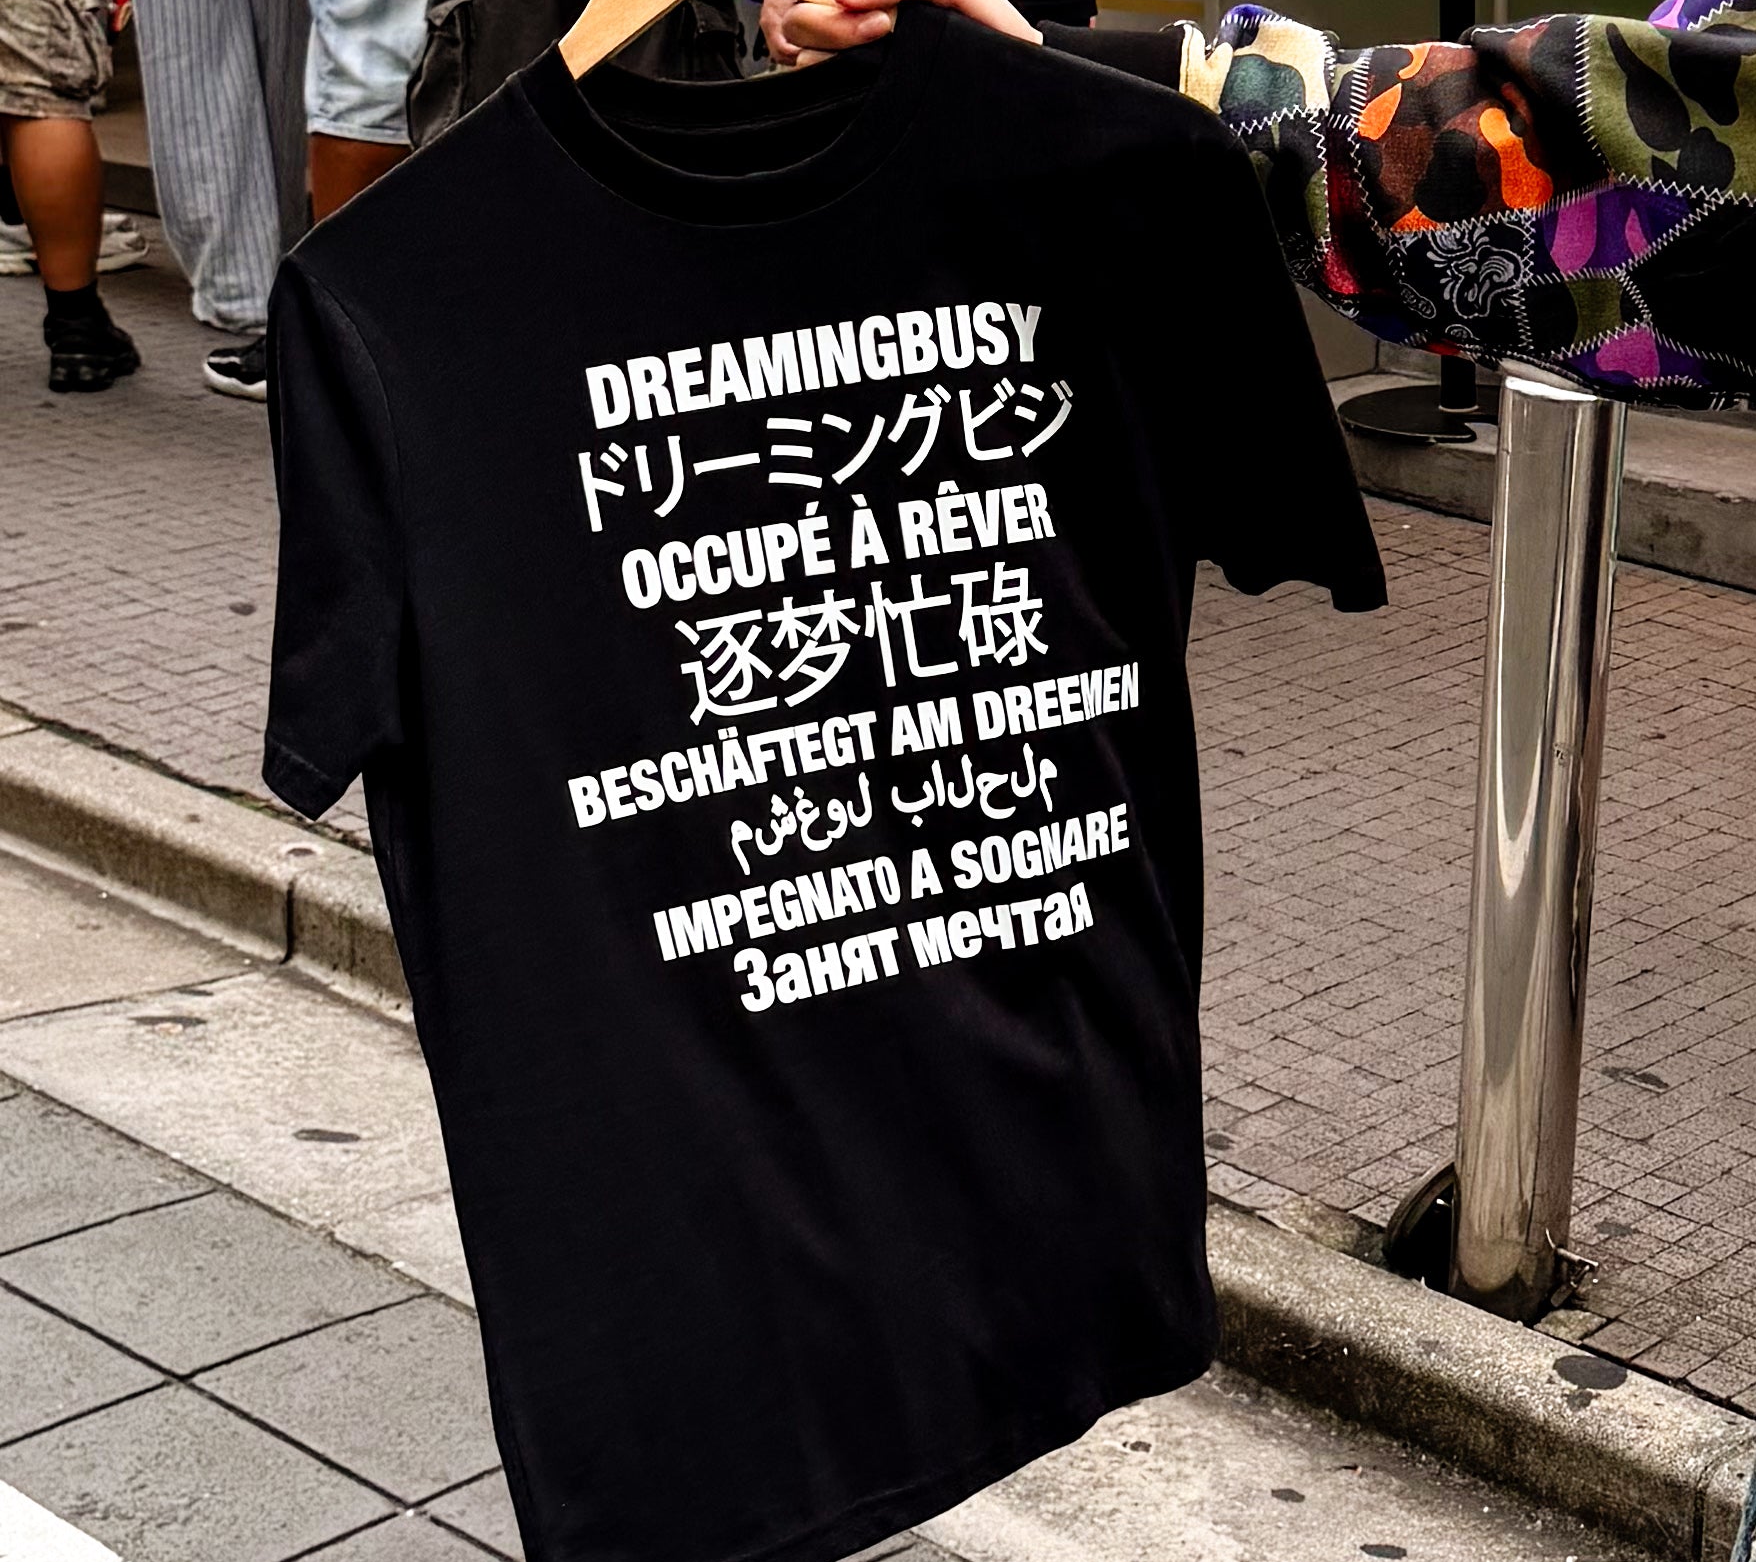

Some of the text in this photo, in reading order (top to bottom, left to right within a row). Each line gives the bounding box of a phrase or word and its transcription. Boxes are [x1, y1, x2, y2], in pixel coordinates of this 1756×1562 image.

[585, 301, 1042, 430] DREAMINGBUSY
[578, 377, 1074, 533] ドリーミングビジ
[621, 479, 1057, 609] OCCUPÉ À RÊVER
[674, 561, 1049, 726] 逐梦忙碌
[567, 661, 1139, 829] BESCHÄFTEGT AM DREEMEN
[652, 802, 1130, 962] IMPEGNATO A SOGNARE
[733, 881, 1094, 1013] Занят мечтая
